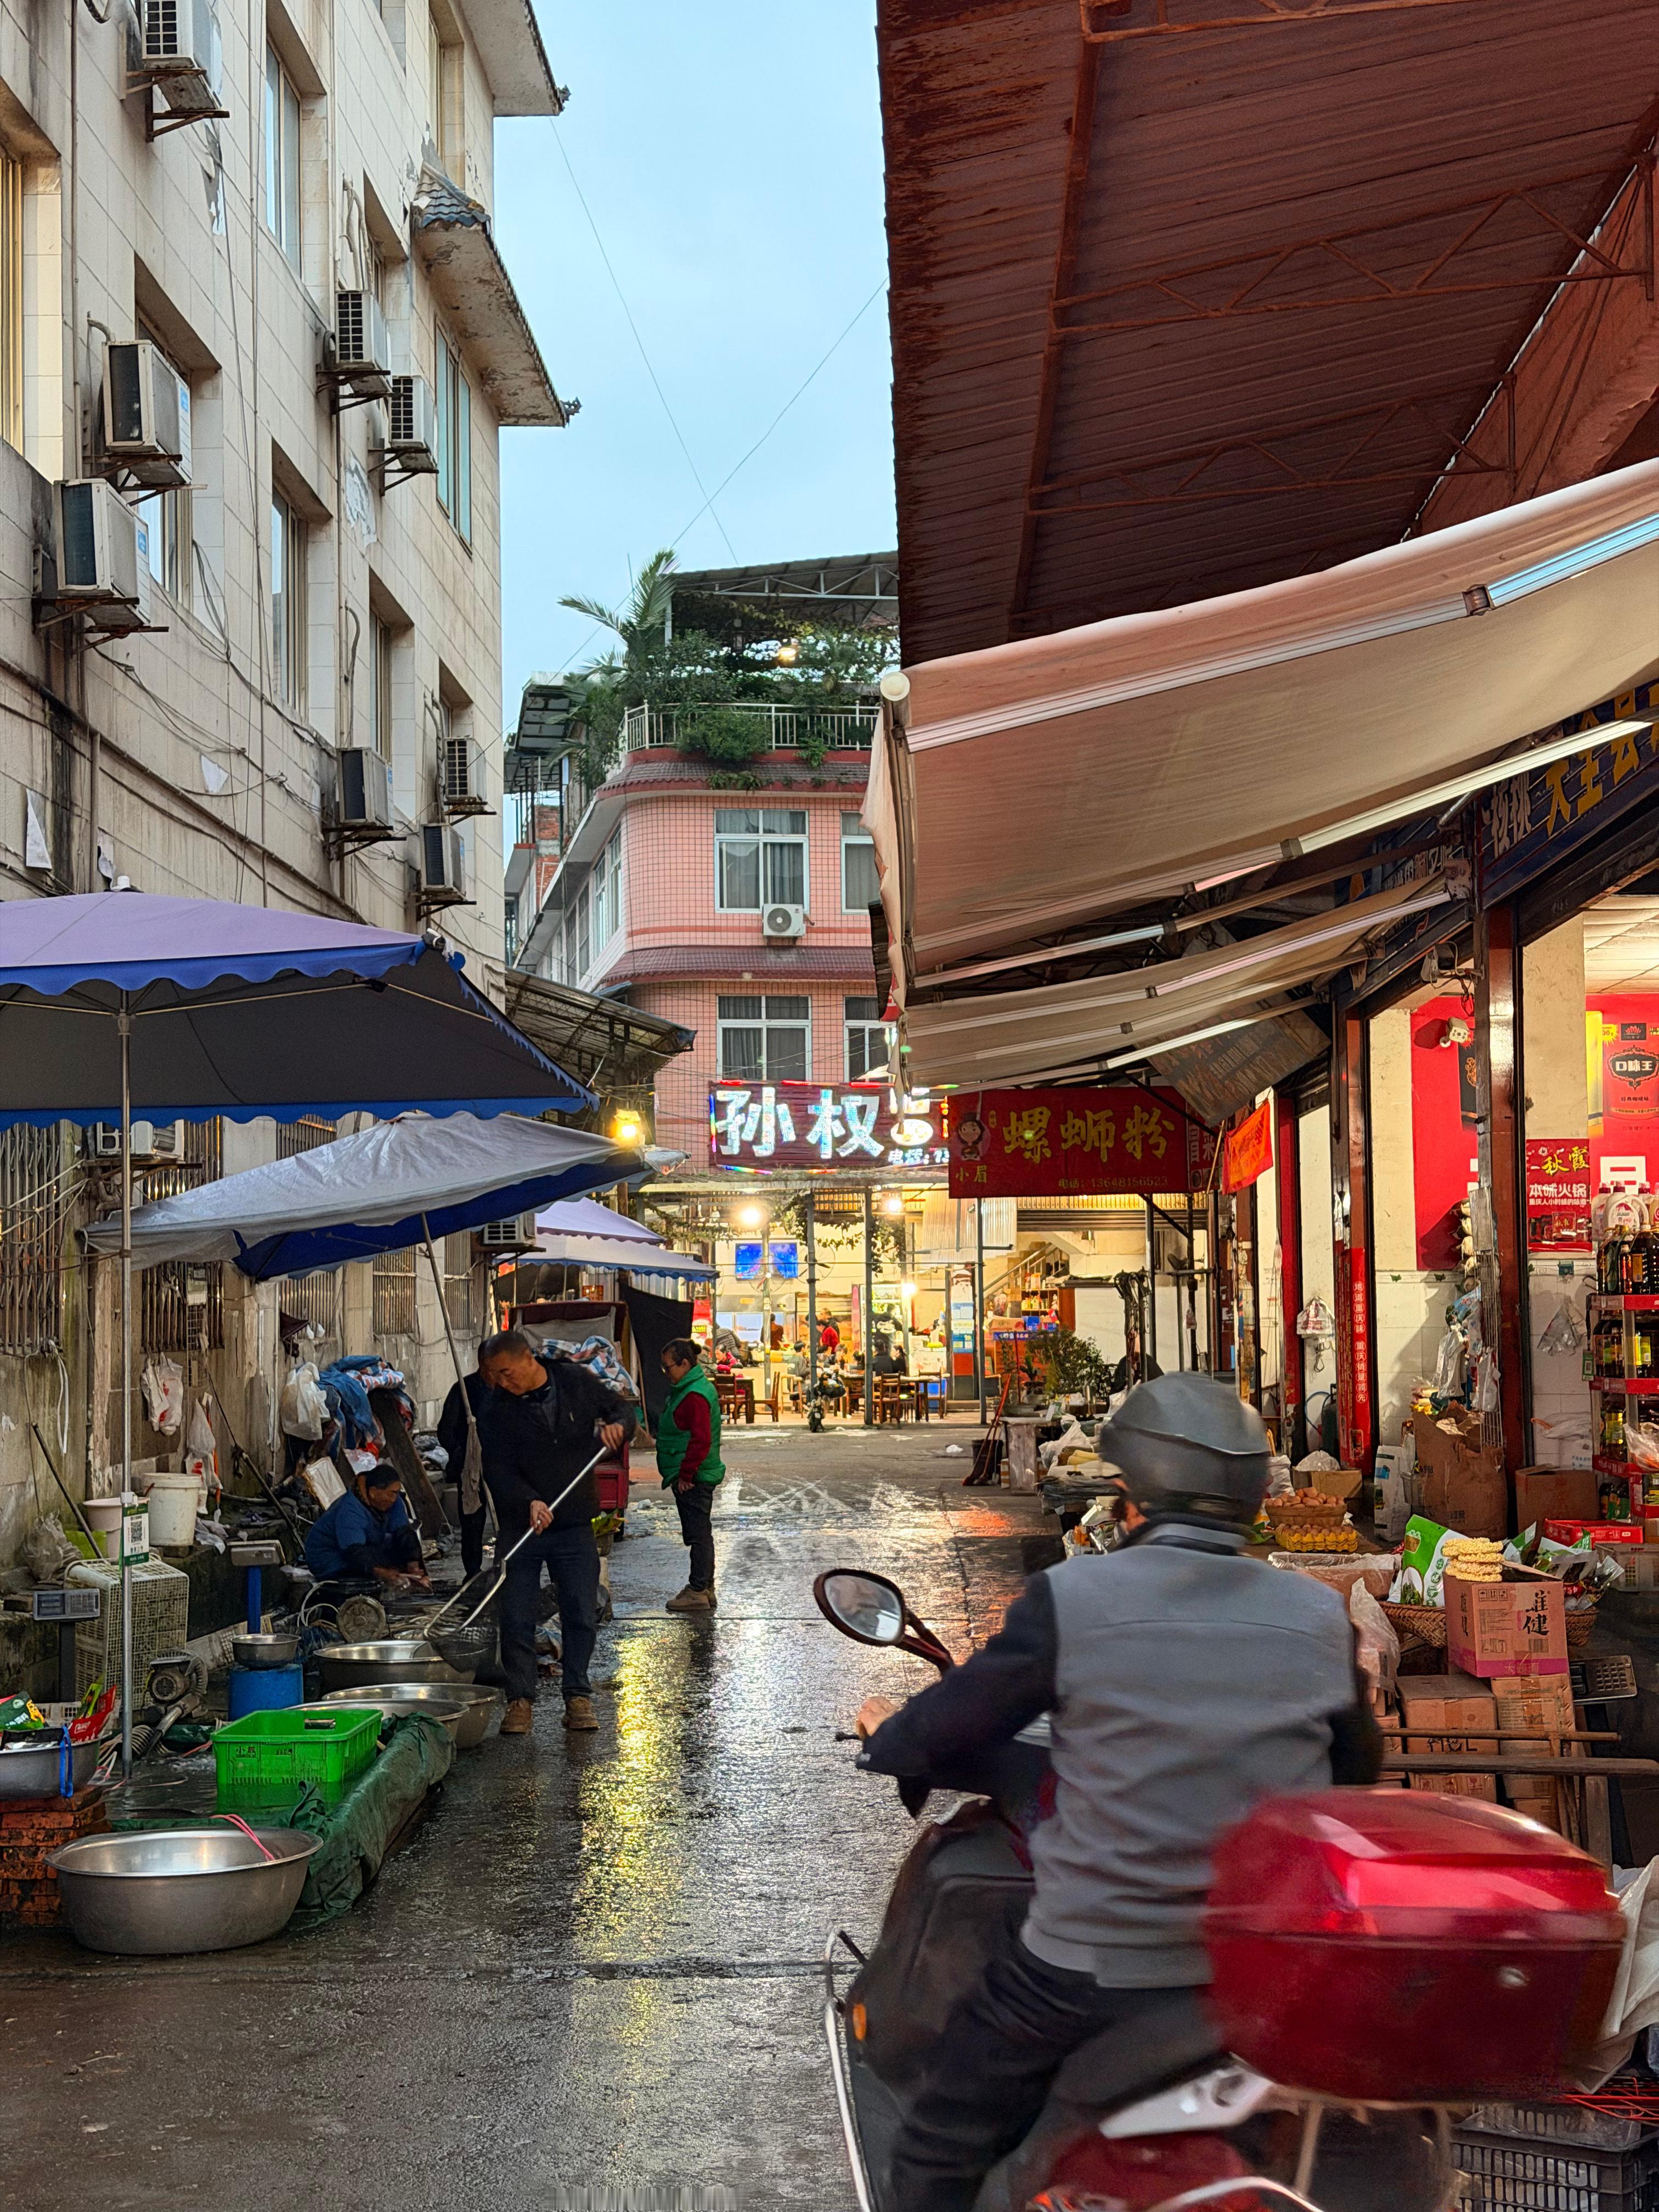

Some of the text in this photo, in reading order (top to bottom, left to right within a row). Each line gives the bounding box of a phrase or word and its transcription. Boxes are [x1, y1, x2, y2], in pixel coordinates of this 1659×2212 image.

[1615, 1059, 1653, 1072] 口味王
[715, 1087, 885, 1159] 孙权
[1002, 1105, 1175, 1164] 螺蛳粉
[955, 1165, 987, 1183] 小眉
[1541, 1146, 1590, 1176] 秋霞
[1529, 1183, 1587, 1198] 本味火锅
[1353, 1280, 1365, 1334] 地道重庆味
